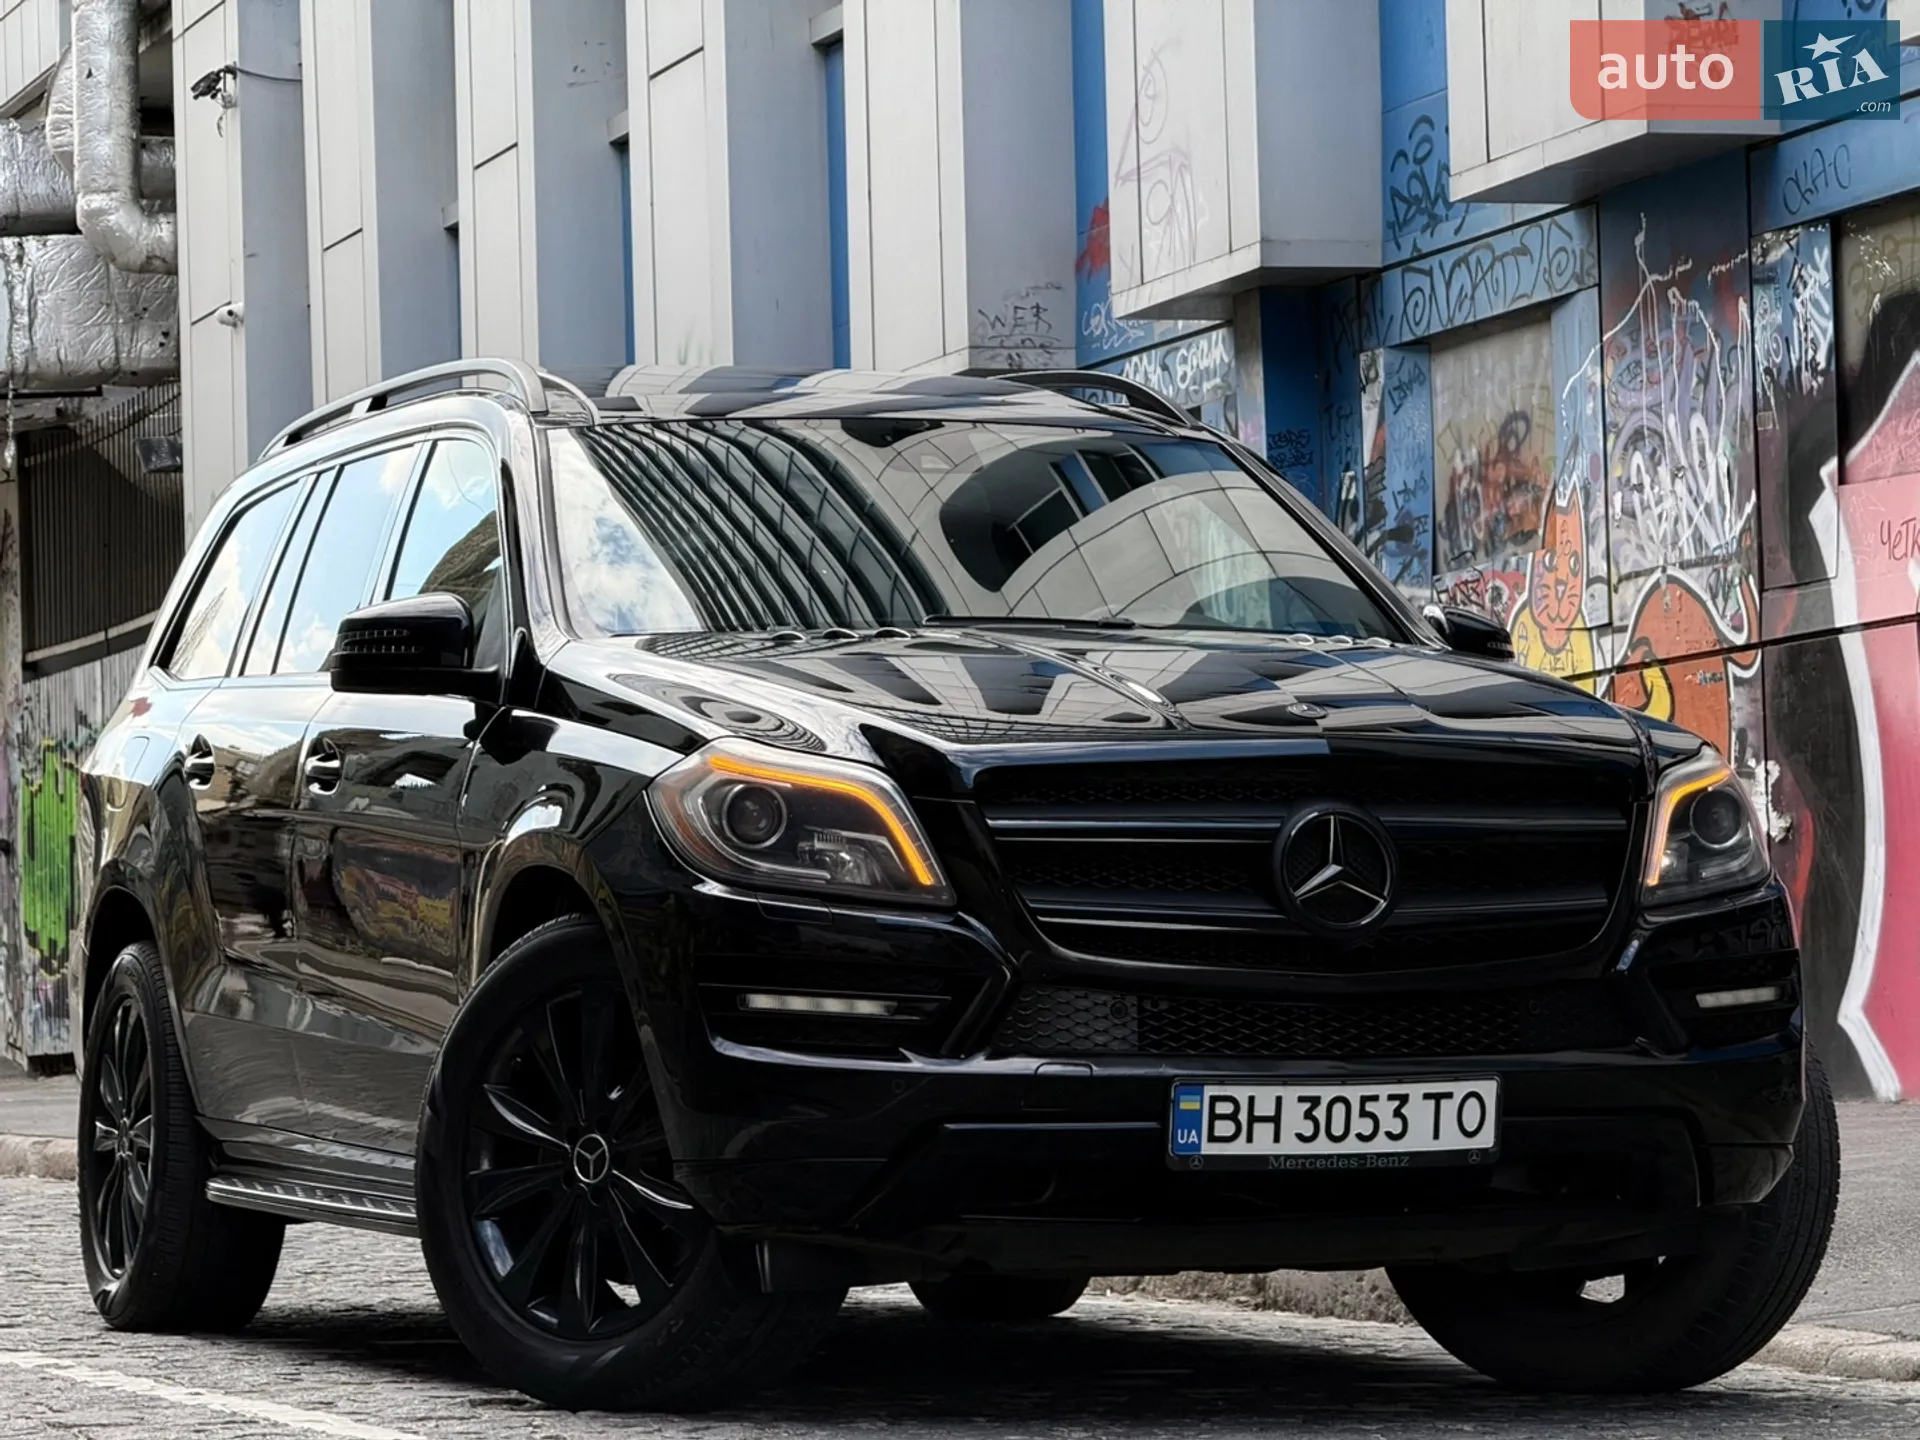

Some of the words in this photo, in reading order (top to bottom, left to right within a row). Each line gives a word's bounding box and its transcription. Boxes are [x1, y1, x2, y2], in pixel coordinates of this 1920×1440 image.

[1206, 1094, 1283, 1144] BH
[1294, 1093, 1410, 1143] 3053
[1422, 1090, 1487, 1140] TO
[1177, 1129, 1199, 1144] UA
[1268, 1155, 1411, 1170] Mercedes-Benz
